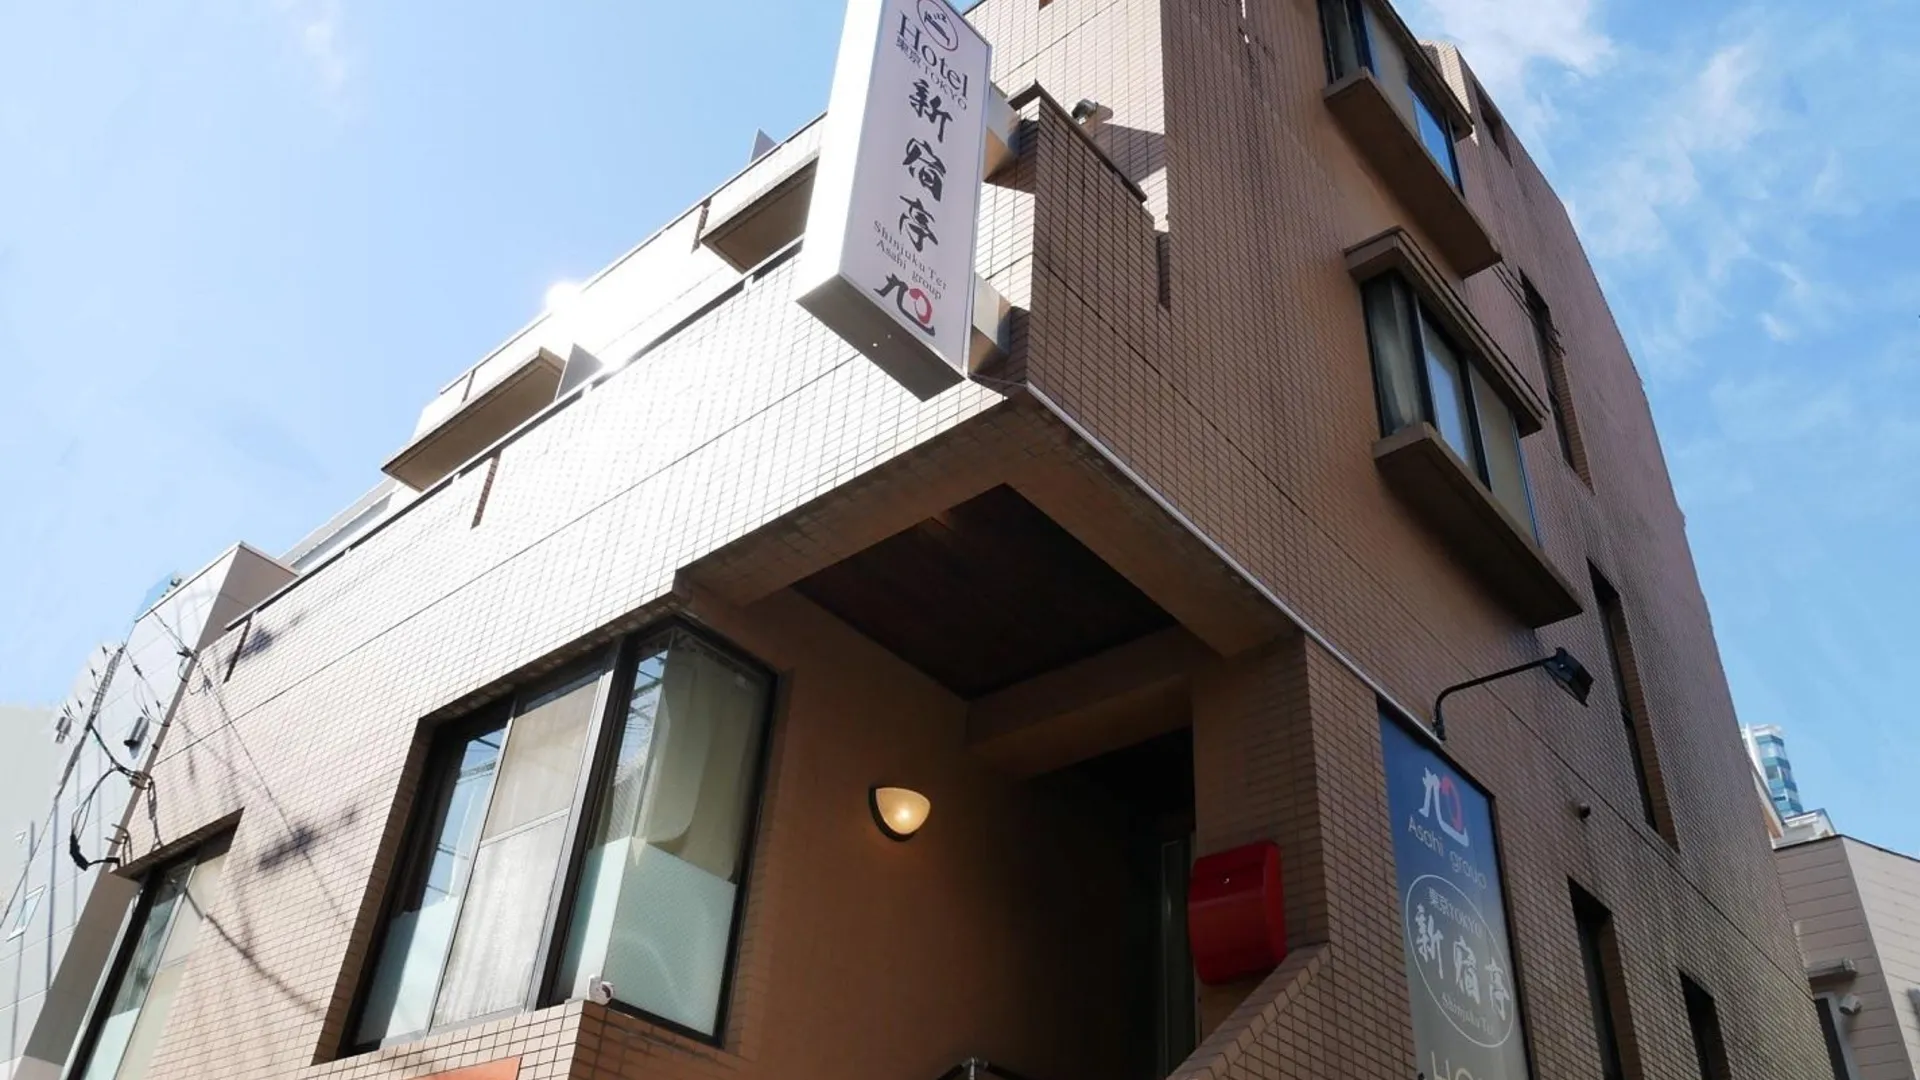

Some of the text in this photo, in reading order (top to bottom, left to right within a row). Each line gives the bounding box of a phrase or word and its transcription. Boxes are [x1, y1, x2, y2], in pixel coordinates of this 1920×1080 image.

[900, 11, 968, 98] Hotel
[873, 219, 926, 274] Shinjuku
[876, 240, 942, 301] Asahi group
[1408, 815, 1444, 857] Asahi
